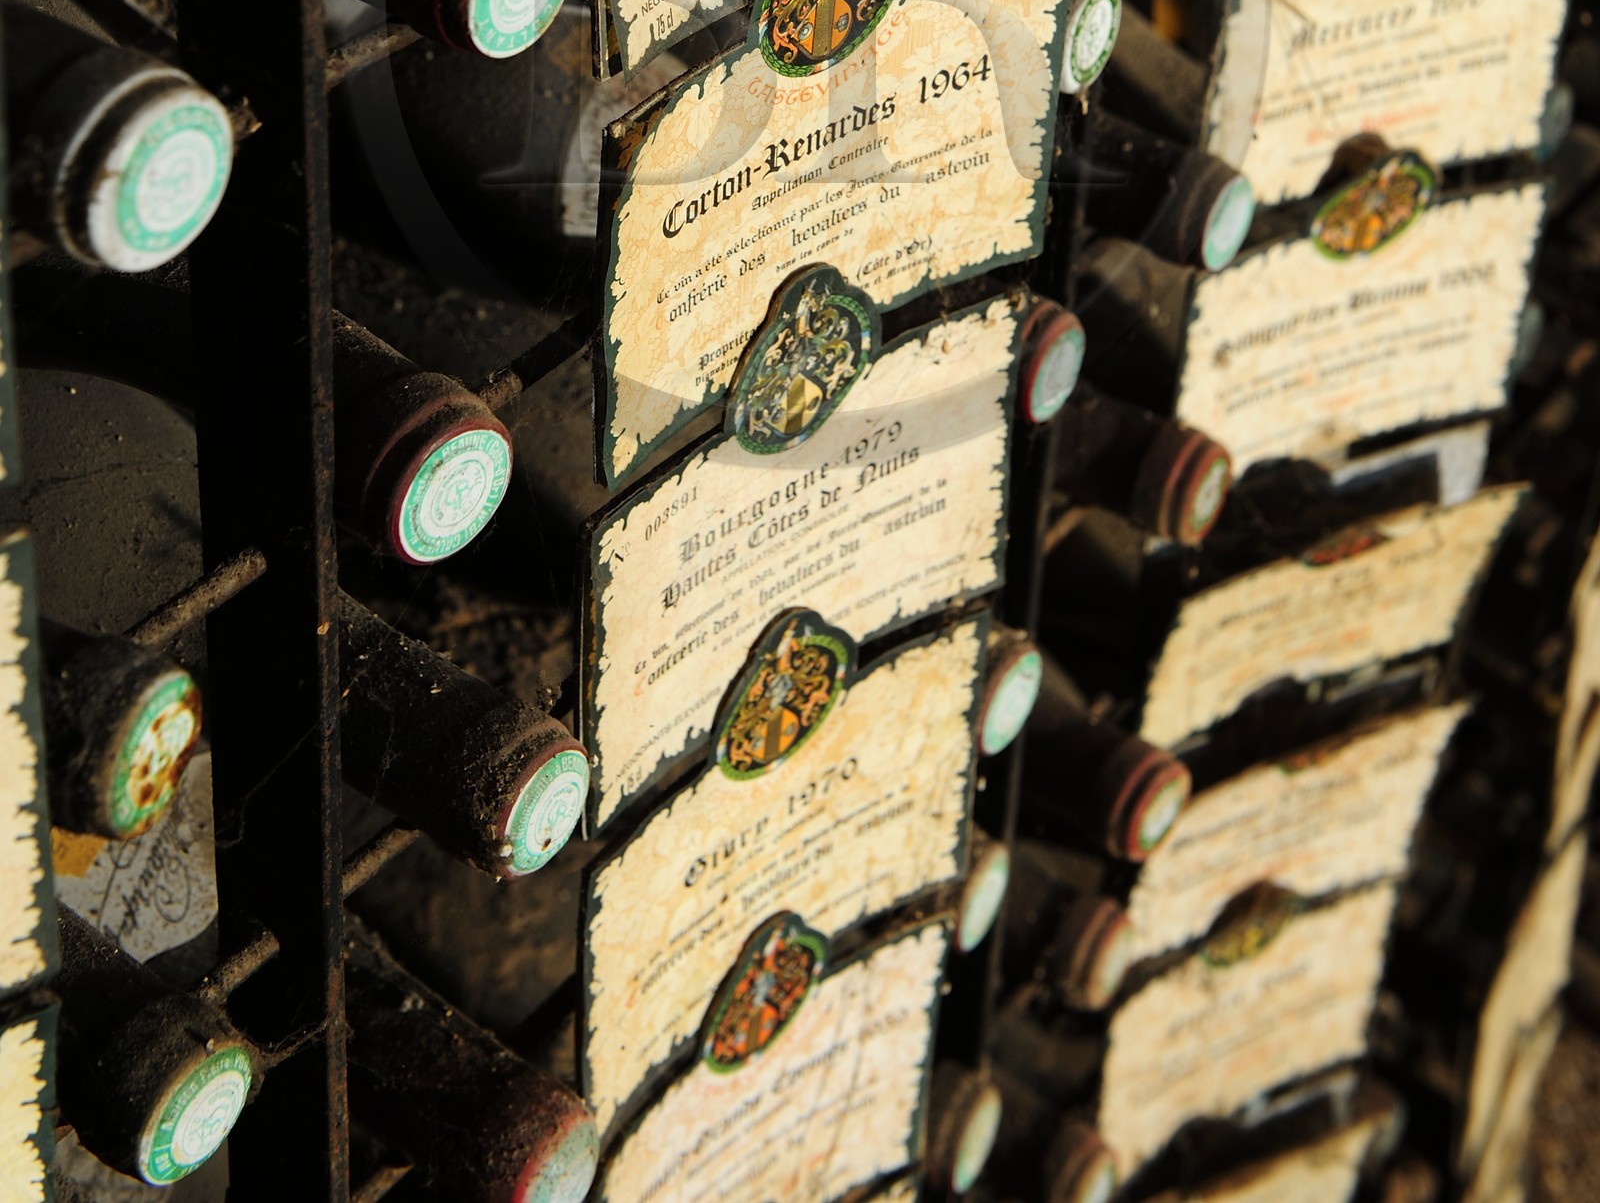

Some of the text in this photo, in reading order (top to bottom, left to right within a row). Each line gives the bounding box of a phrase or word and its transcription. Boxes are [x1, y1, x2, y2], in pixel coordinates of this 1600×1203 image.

[662, 53, 991, 239] Corton-Renardes 1964
[673, 276, 692, 292] vin
[705, 253, 721, 270] été
[725, 210, 796, 260] sélectionné
[799, 200, 822, 223] par
[825, 190, 844, 204] les
[961, 135, 976, 146] de
[980, 127, 992, 139] la
[752, 166, 823, 211] Appellation
[739, 251, 766, 277] des
[879, 184, 900, 204] du
[645, 484, 700, 542] 003891
[661, 447, 920, 618] Hautes Côtes de Nuits
[679, 421, 902, 572] Bourgogne 1979
